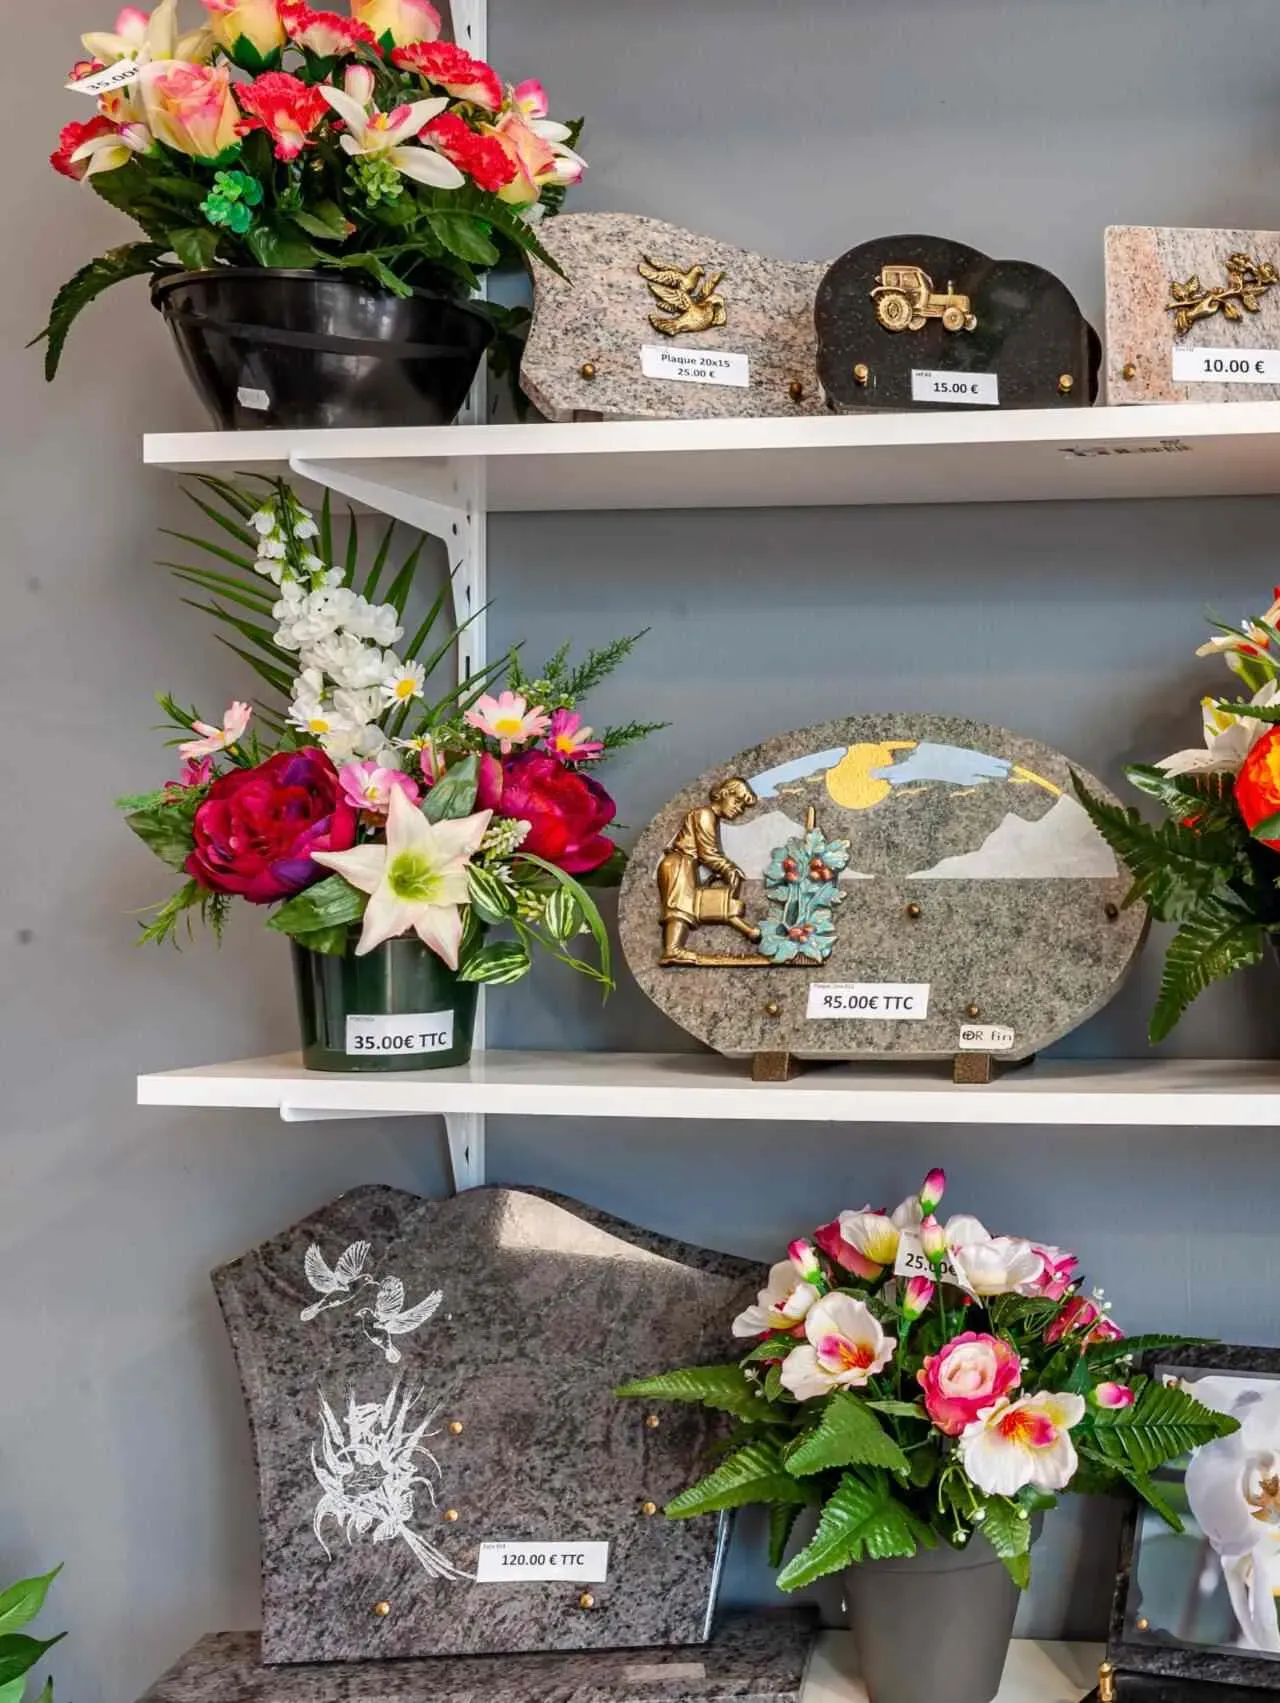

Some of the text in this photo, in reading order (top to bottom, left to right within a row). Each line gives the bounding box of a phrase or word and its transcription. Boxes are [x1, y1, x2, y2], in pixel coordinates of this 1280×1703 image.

[661, 353, 731, 368] Plaque 20x15
[1204, 359, 1265, 374] 10.00 €
[677, 368, 717, 378] 25.00 €
[933, 382, 979, 394] 15.00 €
[824, 995, 914, 1010] 85.00€ TTC
[354, 1032, 448, 1050] 35.00€ TTC
[501, 1554, 584, 1566] 120.00 € TTC
